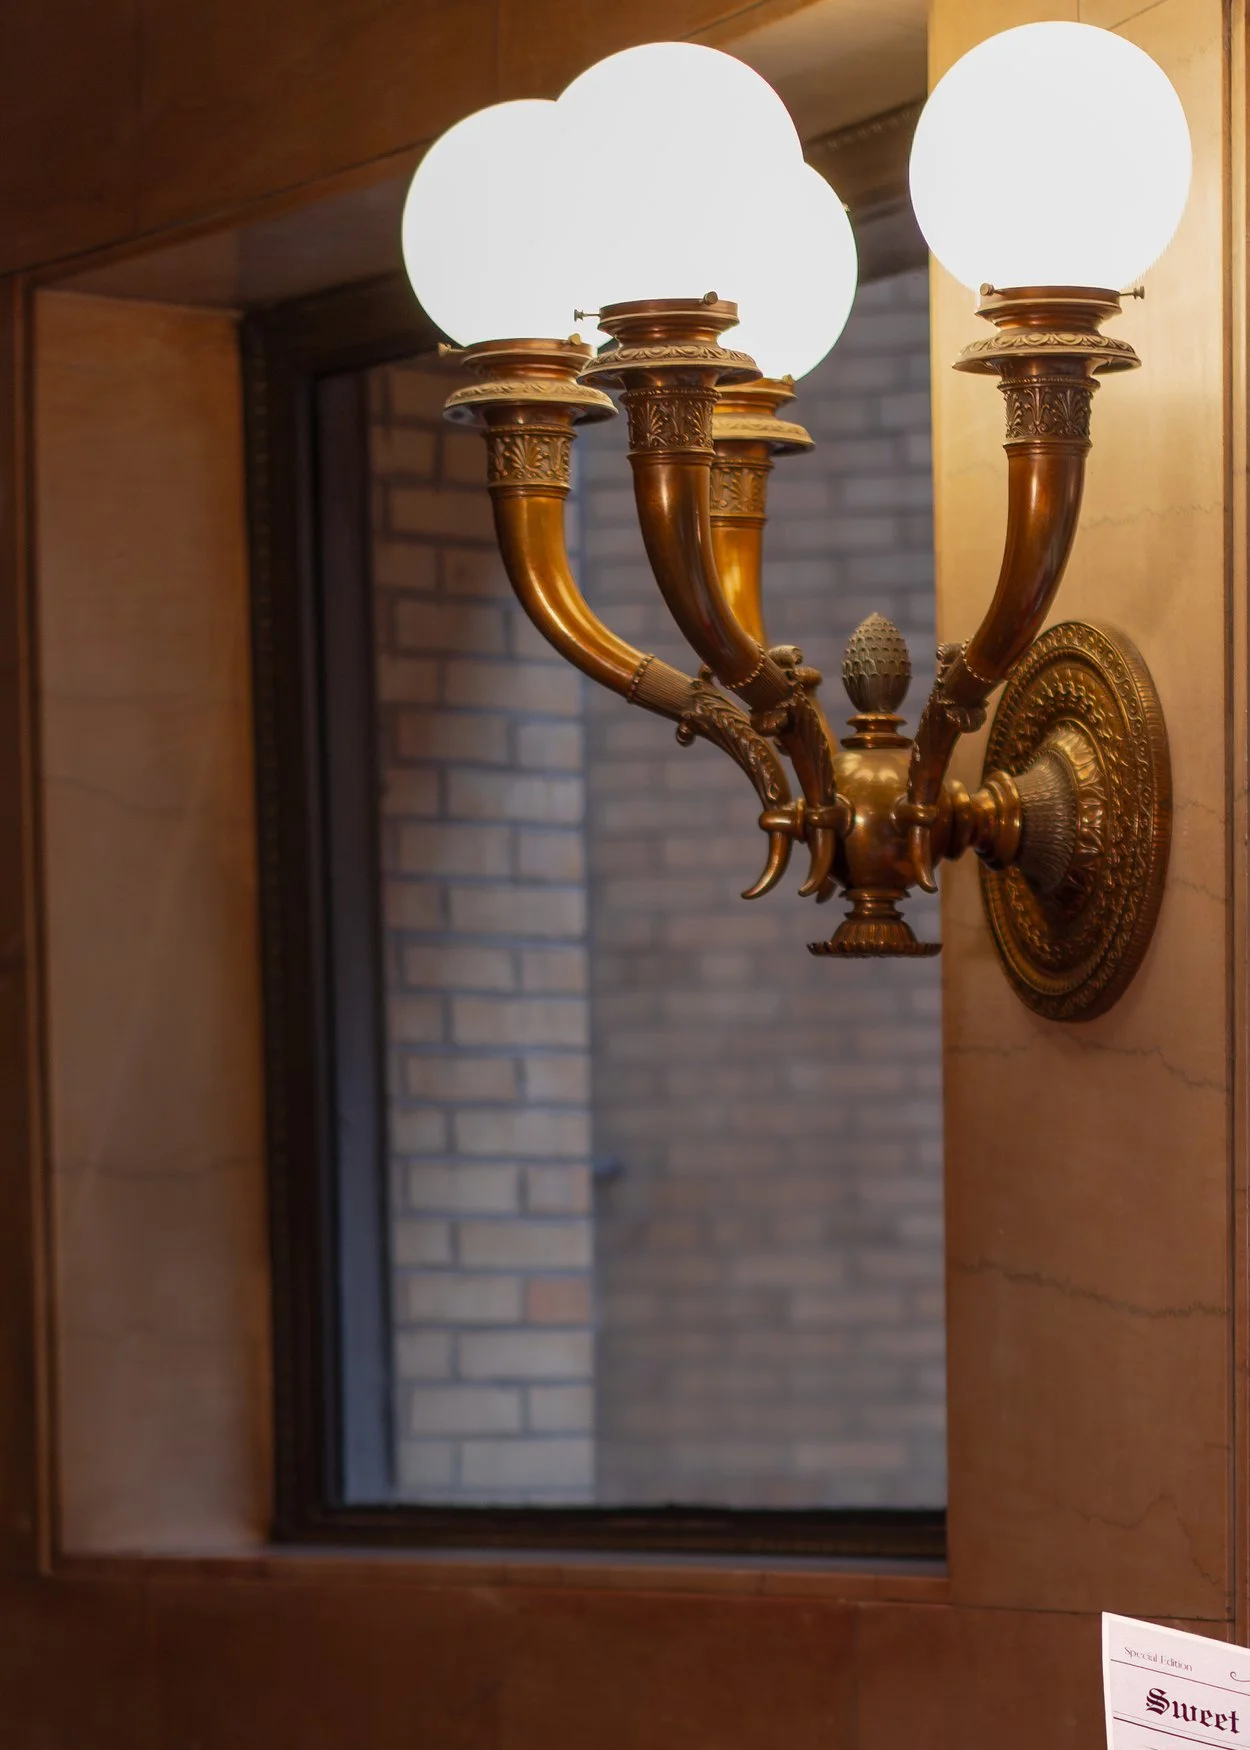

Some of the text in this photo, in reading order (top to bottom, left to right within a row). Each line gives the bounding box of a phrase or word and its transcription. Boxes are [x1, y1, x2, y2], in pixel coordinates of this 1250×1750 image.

[1124, 1646, 1193, 1672] Special Edition
[1146, 1687, 1240, 1734] Sweet
